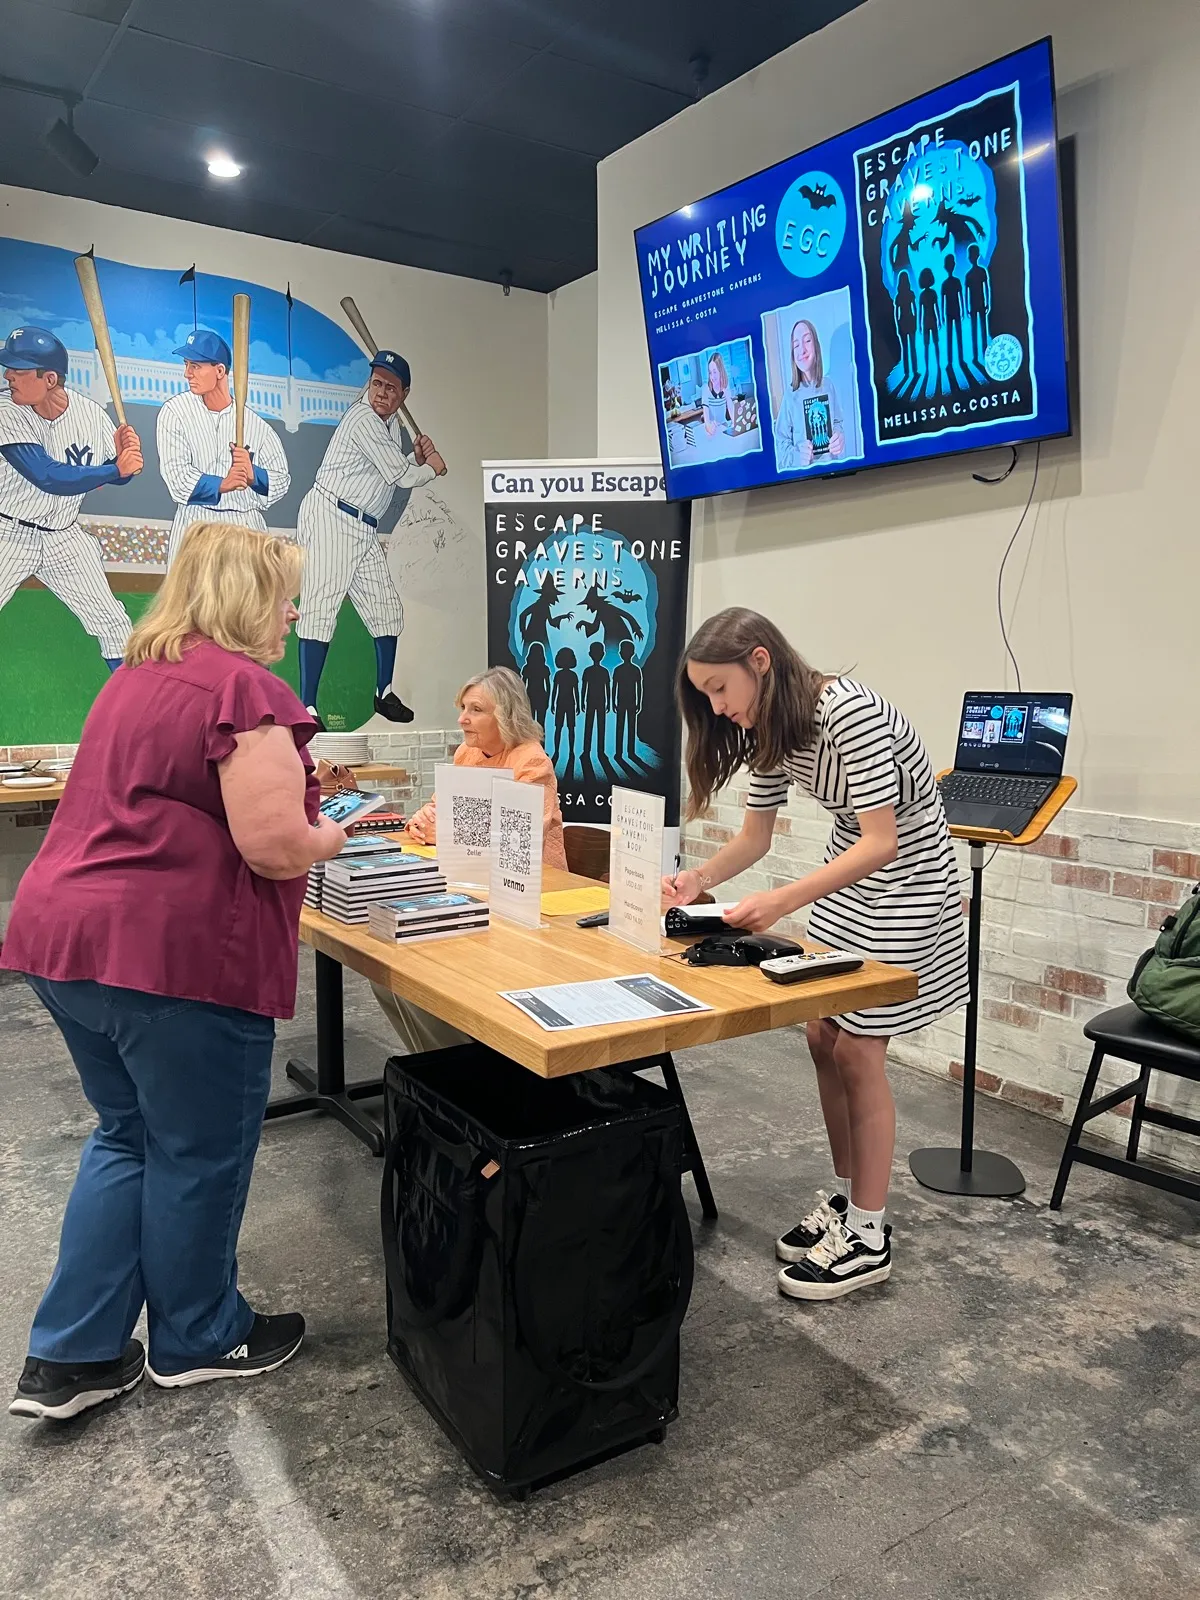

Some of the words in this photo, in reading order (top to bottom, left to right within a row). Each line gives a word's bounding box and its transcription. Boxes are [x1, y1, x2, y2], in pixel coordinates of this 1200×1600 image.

[864, 127, 944, 180] ESCAPE
[866, 127, 1012, 201] GRAVESTONE
[867, 177, 964, 226] CAVERNS
[647, 244, 671, 276] MY
[677, 204, 767, 261] WRITING
[782, 219, 831, 258] EGC
[651, 238, 747, 298] JOURNEY
[654, 304, 678, 319] ESCAPE
[682, 287, 725, 308] GRAVESTONE
[729, 273, 762, 291] CAVERNS
[655, 318, 684, 334] MELISSA
[695, 306, 718, 320] COSTA
[884, 403, 948, 429] MELISSA
[952, 395, 967, 415] C.
[969, 390, 1021, 412] COSTA
[491, 473, 535, 494] Can
[540, 478, 585, 498] you
[495, 513, 603, 536] ESCAPE
[495, 540, 682, 564] GRAVESTONE
[495, 567, 624, 590] CAVERNS
[624, 804, 647, 818] ESCAPE
[466, 848, 482, 857] Zelle
[627, 841, 642, 852] BOOK
[503, 878, 525, 893] venmo
[624, 866, 645, 880] Paperback
